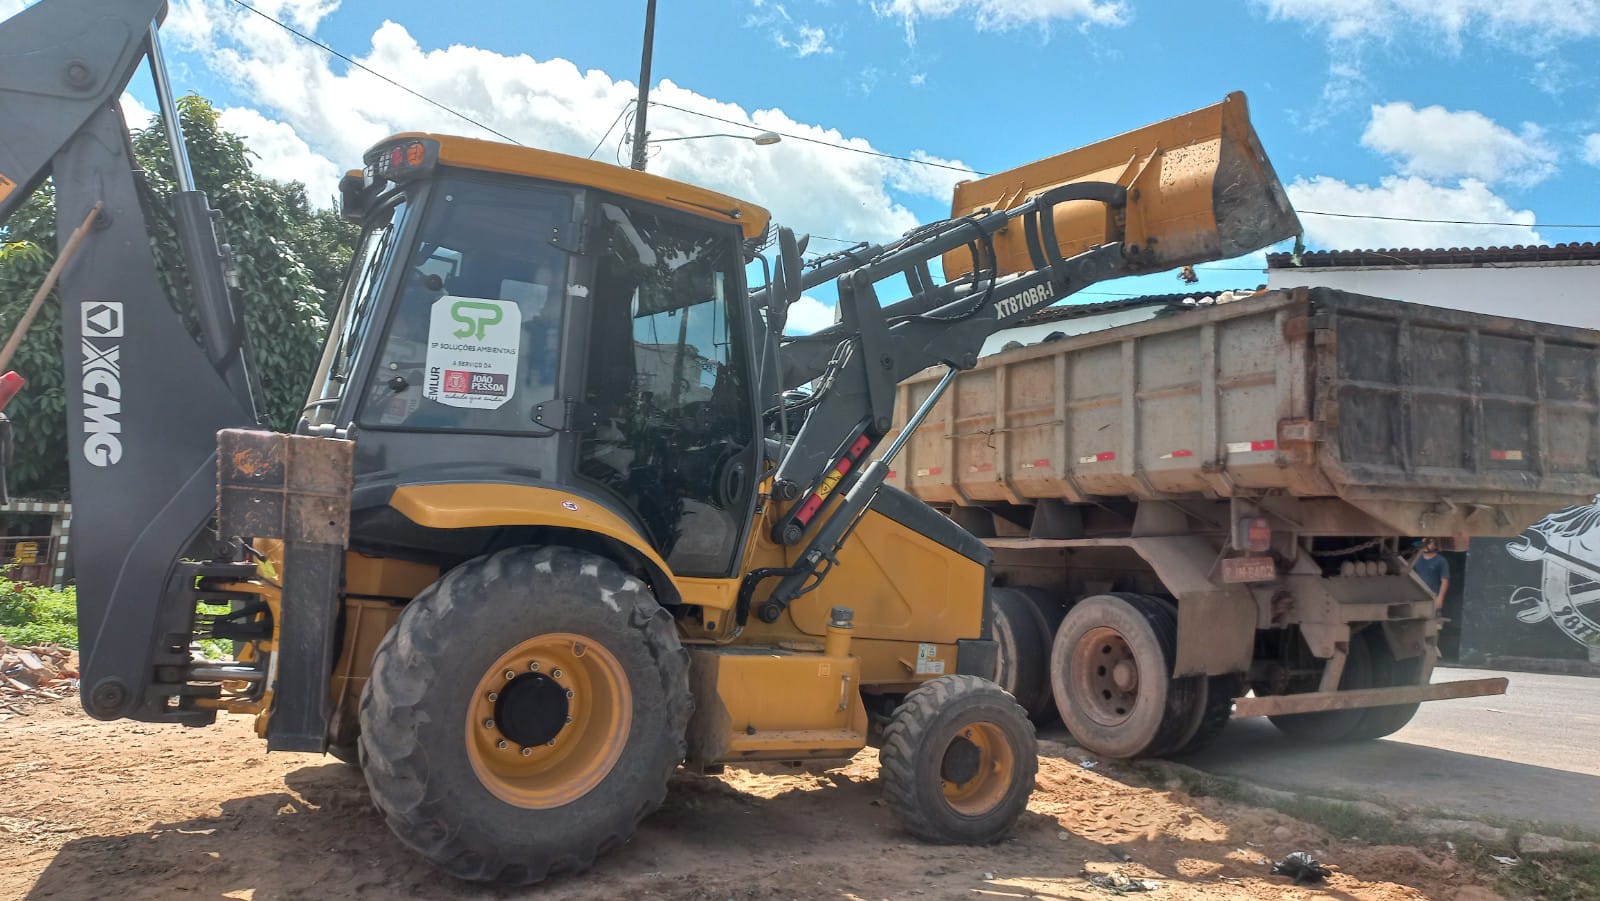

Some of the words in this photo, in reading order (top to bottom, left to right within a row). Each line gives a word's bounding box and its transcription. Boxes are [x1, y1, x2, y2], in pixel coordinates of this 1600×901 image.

[451, 300, 503, 341] SP
[440, 343, 476, 352] SOLUÇÕES
[471, 382, 504, 391] PESSOA
[81, 336, 123, 467] XCMG
